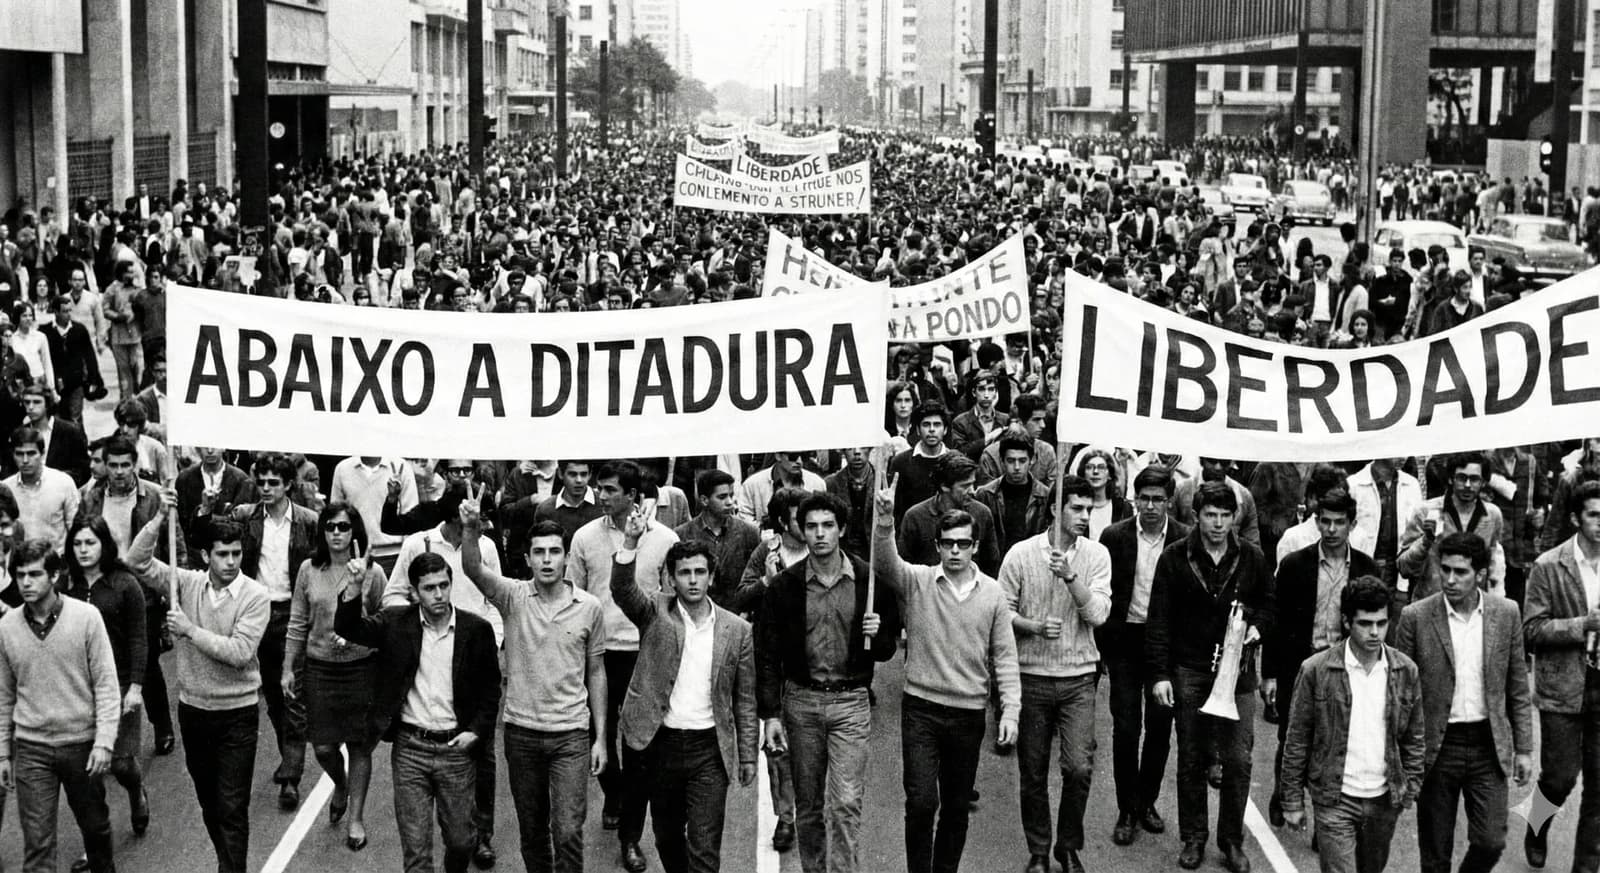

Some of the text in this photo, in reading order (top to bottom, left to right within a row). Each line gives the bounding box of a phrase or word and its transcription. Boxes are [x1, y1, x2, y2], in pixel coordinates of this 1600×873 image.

[737, 154, 823, 183] LIBERDADE
[836, 169, 863, 186] NOS
[679, 181, 769, 207] CONLEMENTO
[775, 196, 784, 208] A
[926, 291, 1022, 341] PONDO
[185, 322, 870, 418] ABAIXO A DITADURA
[1075, 295, 1600, 434] LIBERDADE
